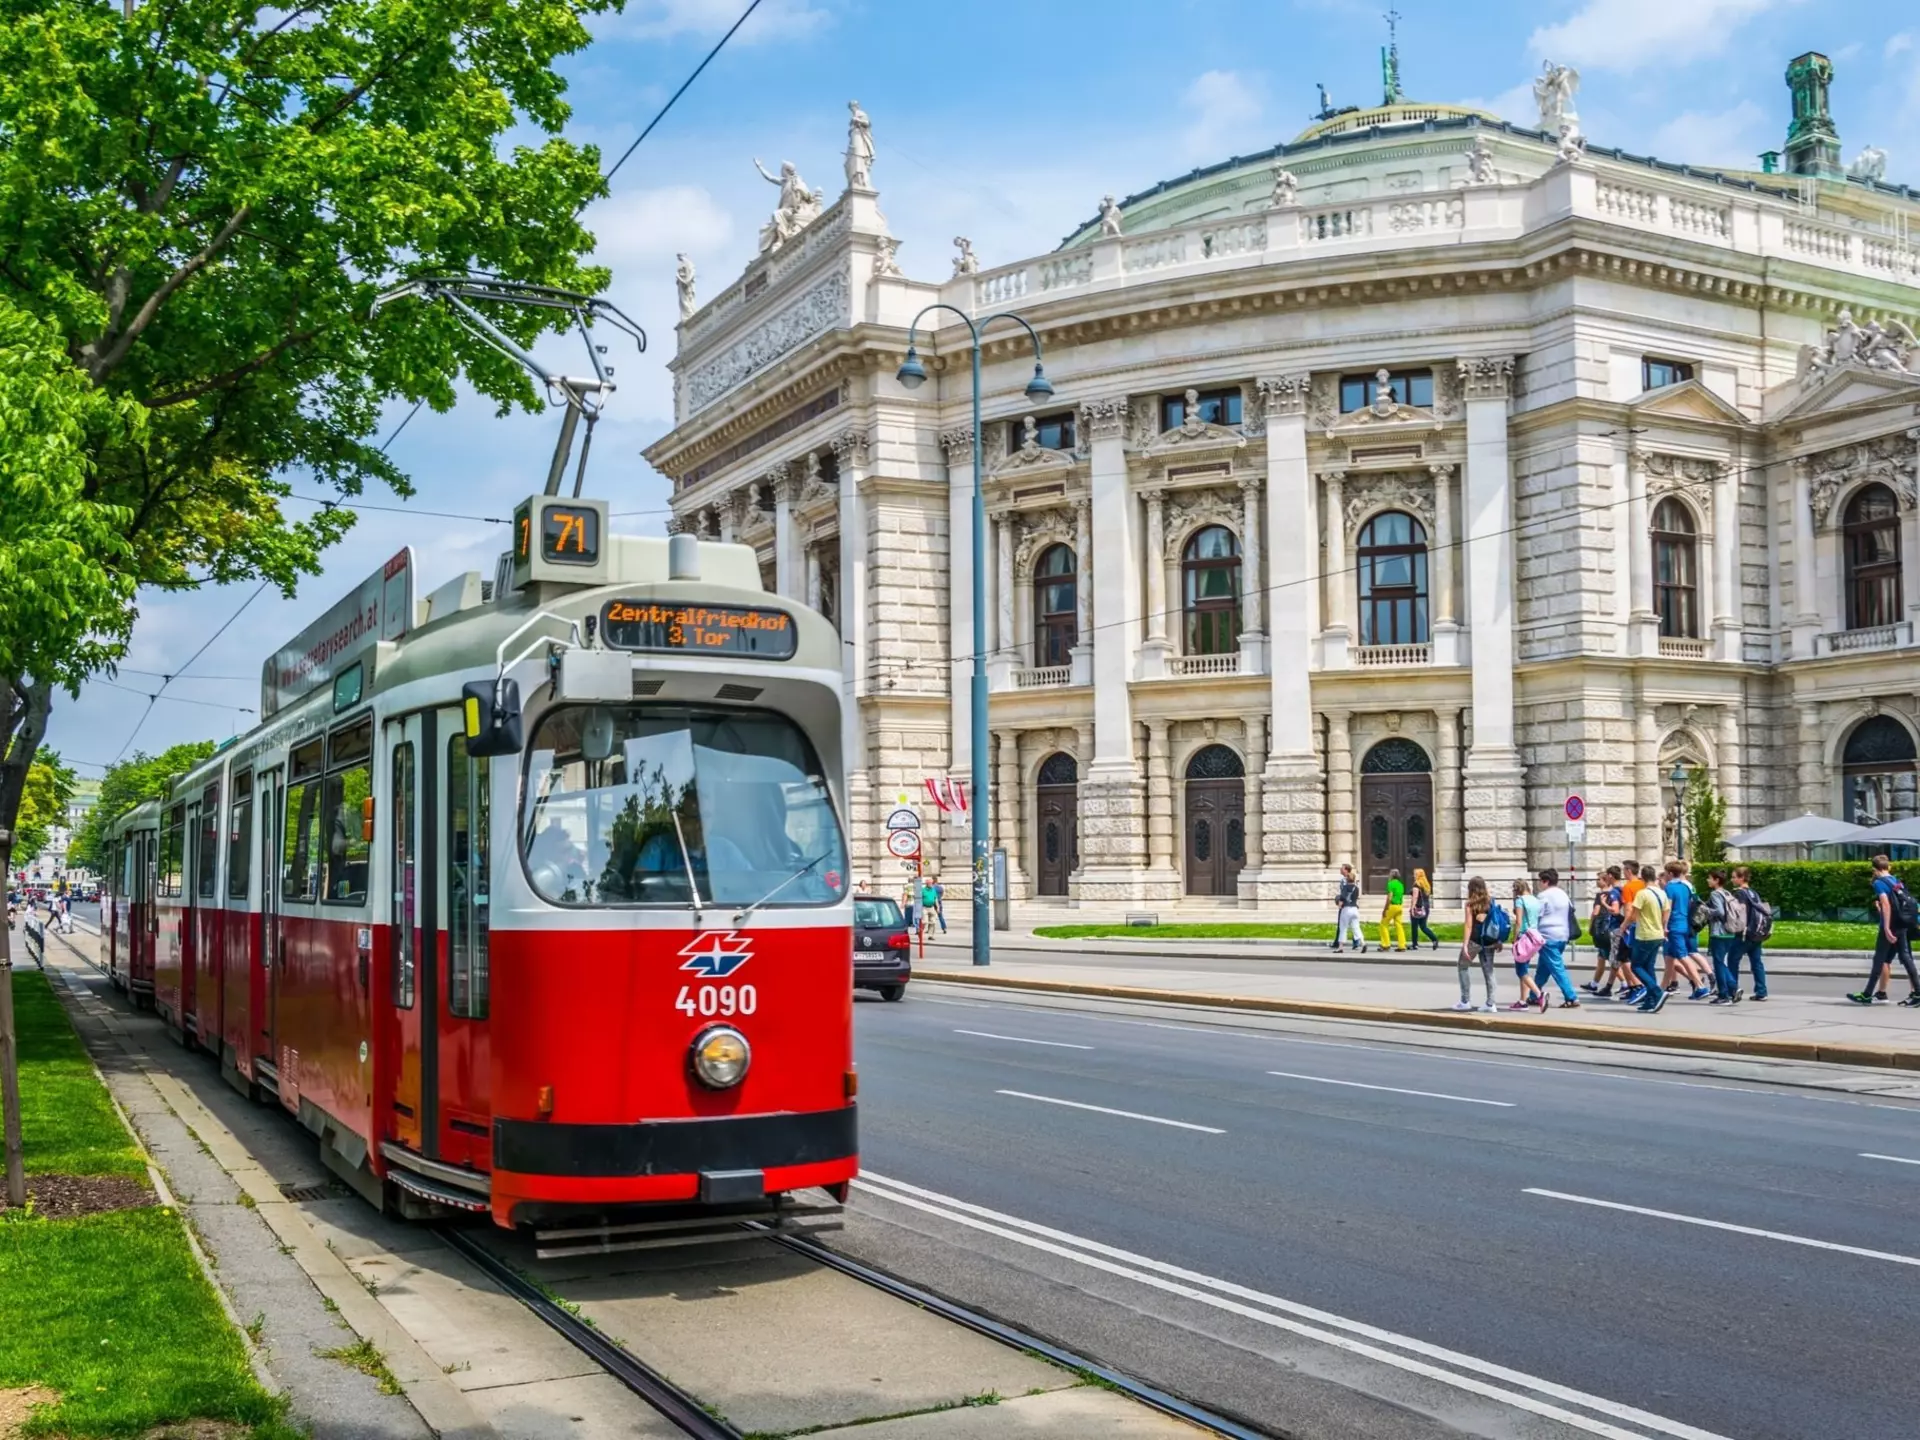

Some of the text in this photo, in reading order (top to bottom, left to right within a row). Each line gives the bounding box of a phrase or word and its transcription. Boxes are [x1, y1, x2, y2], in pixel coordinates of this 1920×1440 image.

[553, 513, 585, 553] 71
[607, 603, 789, 630] Zentralfriedhof
[668, 626, 731, 646] 3. Tor
[675, 985, 757, 1017] 4090
